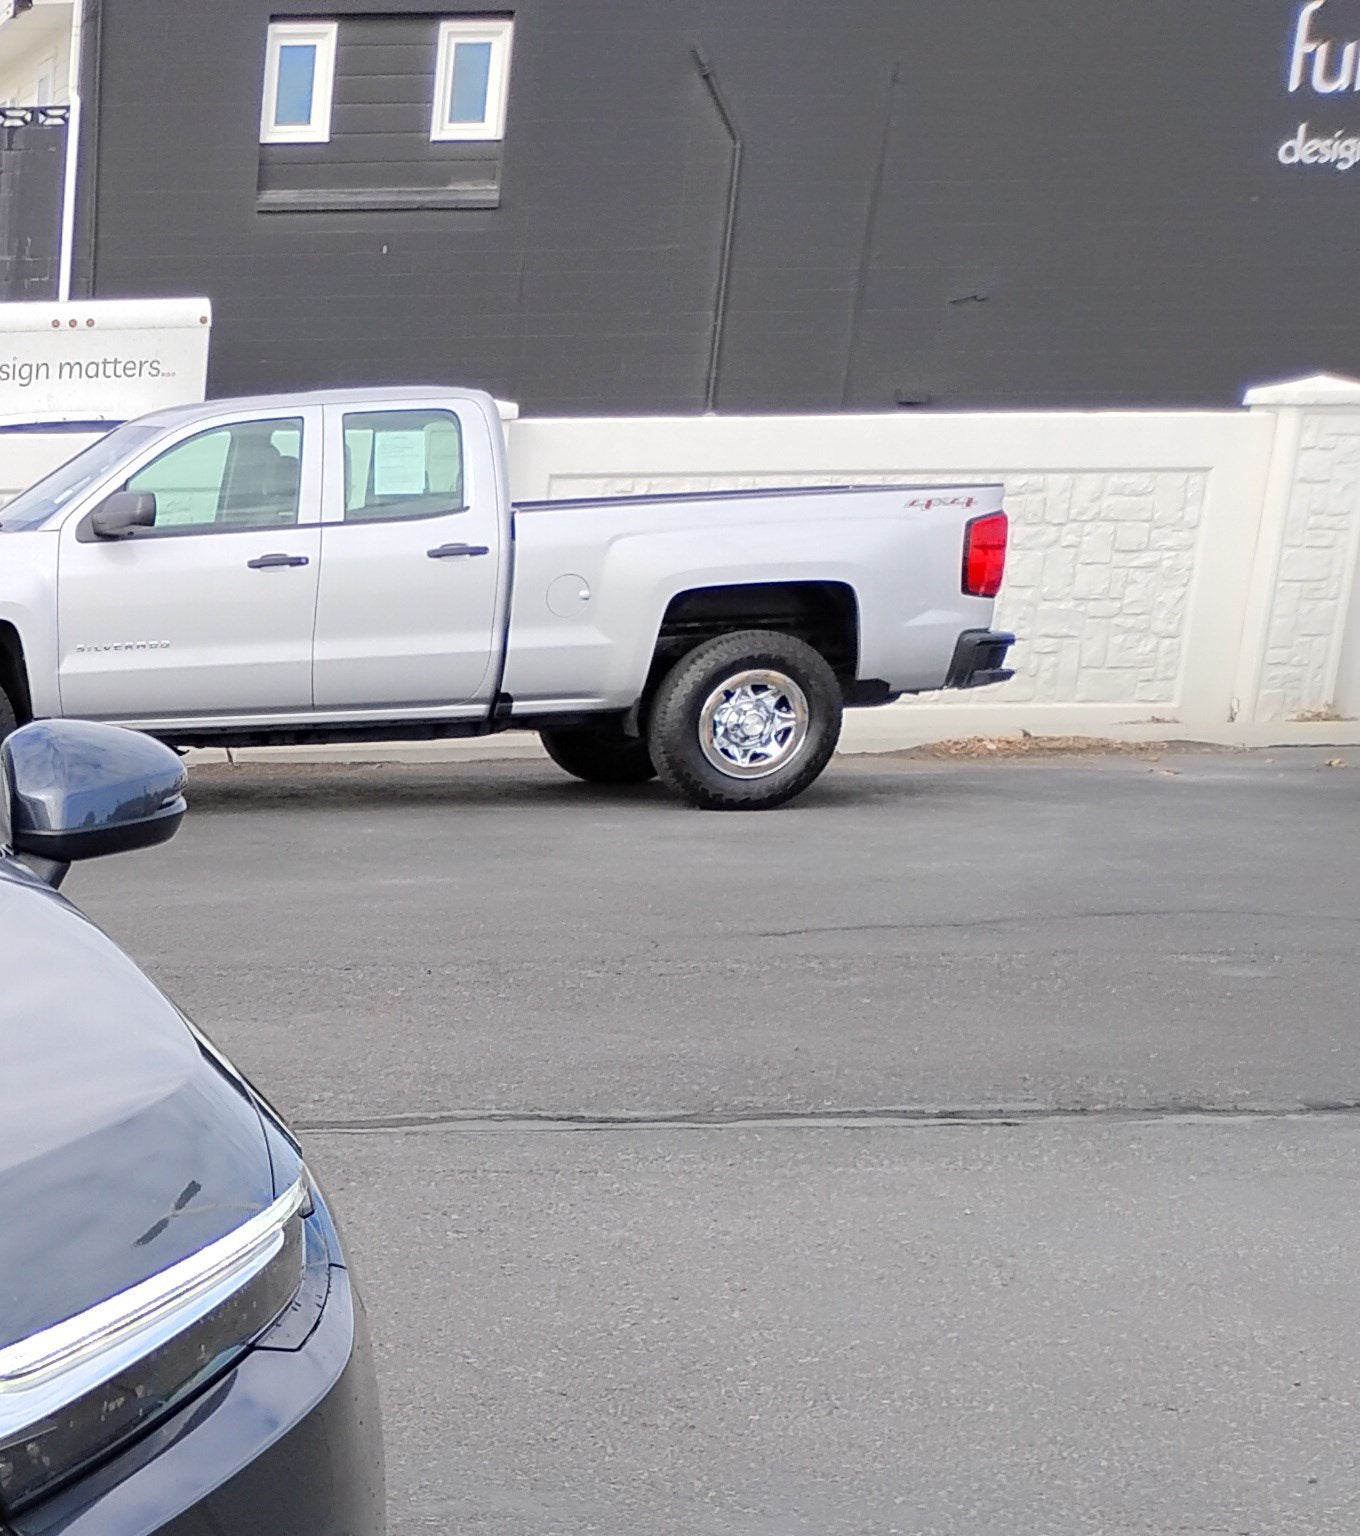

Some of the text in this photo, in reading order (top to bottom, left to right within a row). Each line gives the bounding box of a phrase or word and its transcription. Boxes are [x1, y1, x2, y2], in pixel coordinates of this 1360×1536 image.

[1288, 0, 1360, 93] fu
[1278, 121, 1360, 170] desig
[76, 640, 170, 653] SILVERADO
